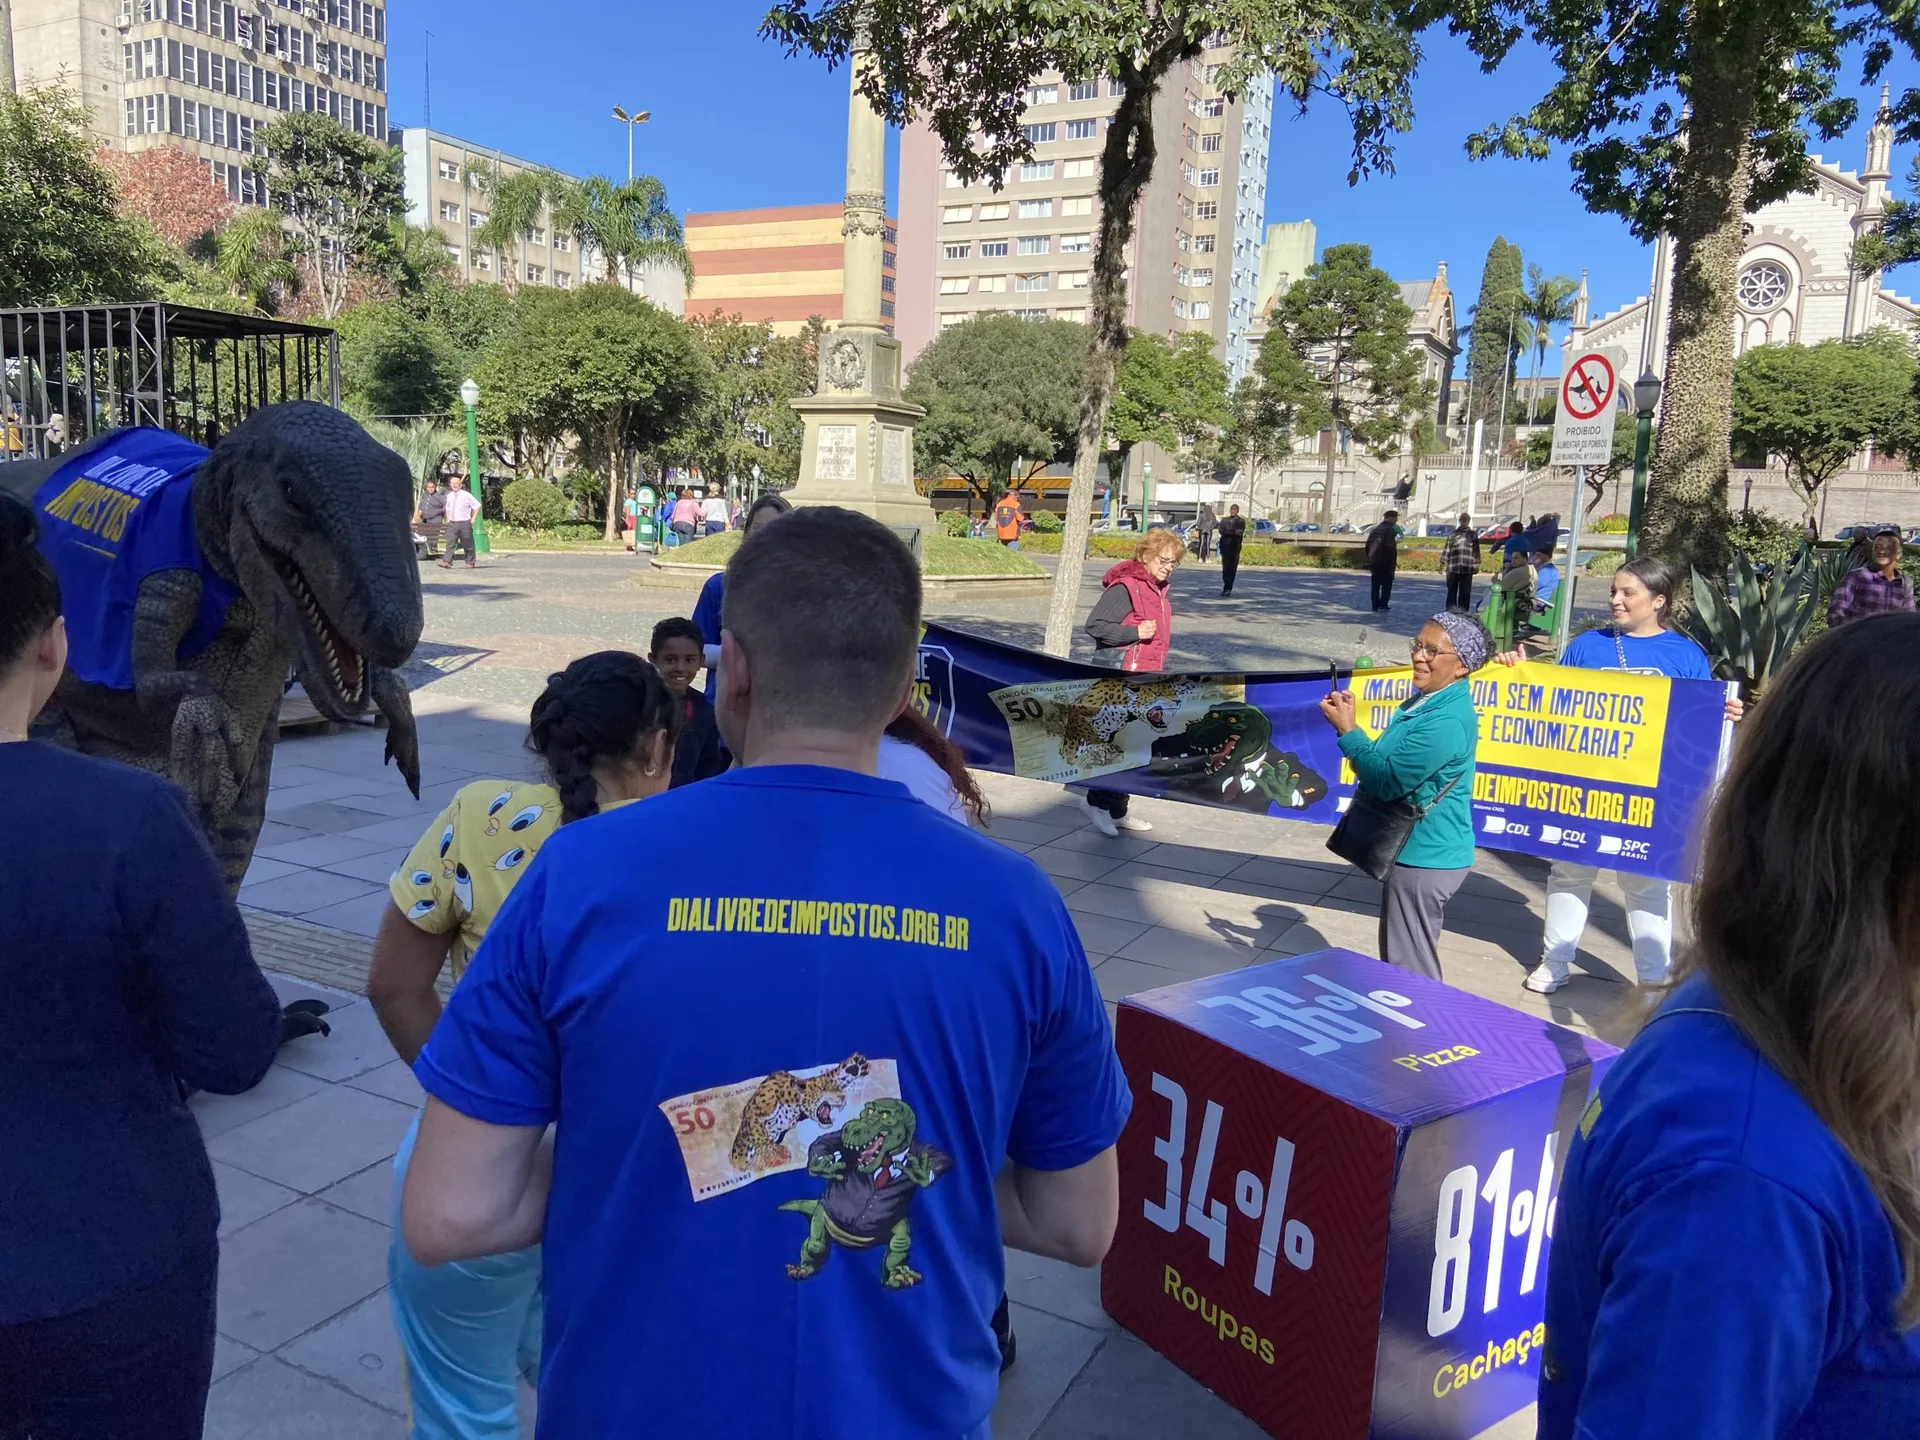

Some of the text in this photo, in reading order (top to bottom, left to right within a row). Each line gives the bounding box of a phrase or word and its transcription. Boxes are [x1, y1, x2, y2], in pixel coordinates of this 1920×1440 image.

[1566, 426, 1601, 436] PROIBIDO
[44, 477, 141, 542] IMPOSTOS
[998, 690, 1020, 701] BANCO
[1021, 687, 1053, 697] CENTRAL
[1005, 697, 1044, 722] 50
[1362, 678, 1647, 726] IMAGI DIA SEM IMPOSTOS.
[1490, 714, 1634, 760] ECONOMIZARIA?
[1472, 771, 1655, 828] DEIMPOSTOS.ORG.BR
[1506, 822, 1531, 836] CDL
[1562, 829, 1587, 844] CDL
[1562, 841, 1580, 849] Jovem
[1622, 839, 1651, 854] SPC
[1620, 851, 1649, 861] BRASIL
[667, 897, 969, 951] DIALIVREDEIMPOSTOS.ORG.BR
[1196, 973, 1426, 1057] 36%
[1393, 1042, 1482, 1073] Pizza
[675, 1107, 716, 1135] 50
[1143, 1071, 1315, 1297] 34%
[1427, 1130, 1561, 1338] 81%
[1163, 1264, 1276, 1365] Roupas
[1433, 1321, 1547, 1399] Cachaça
